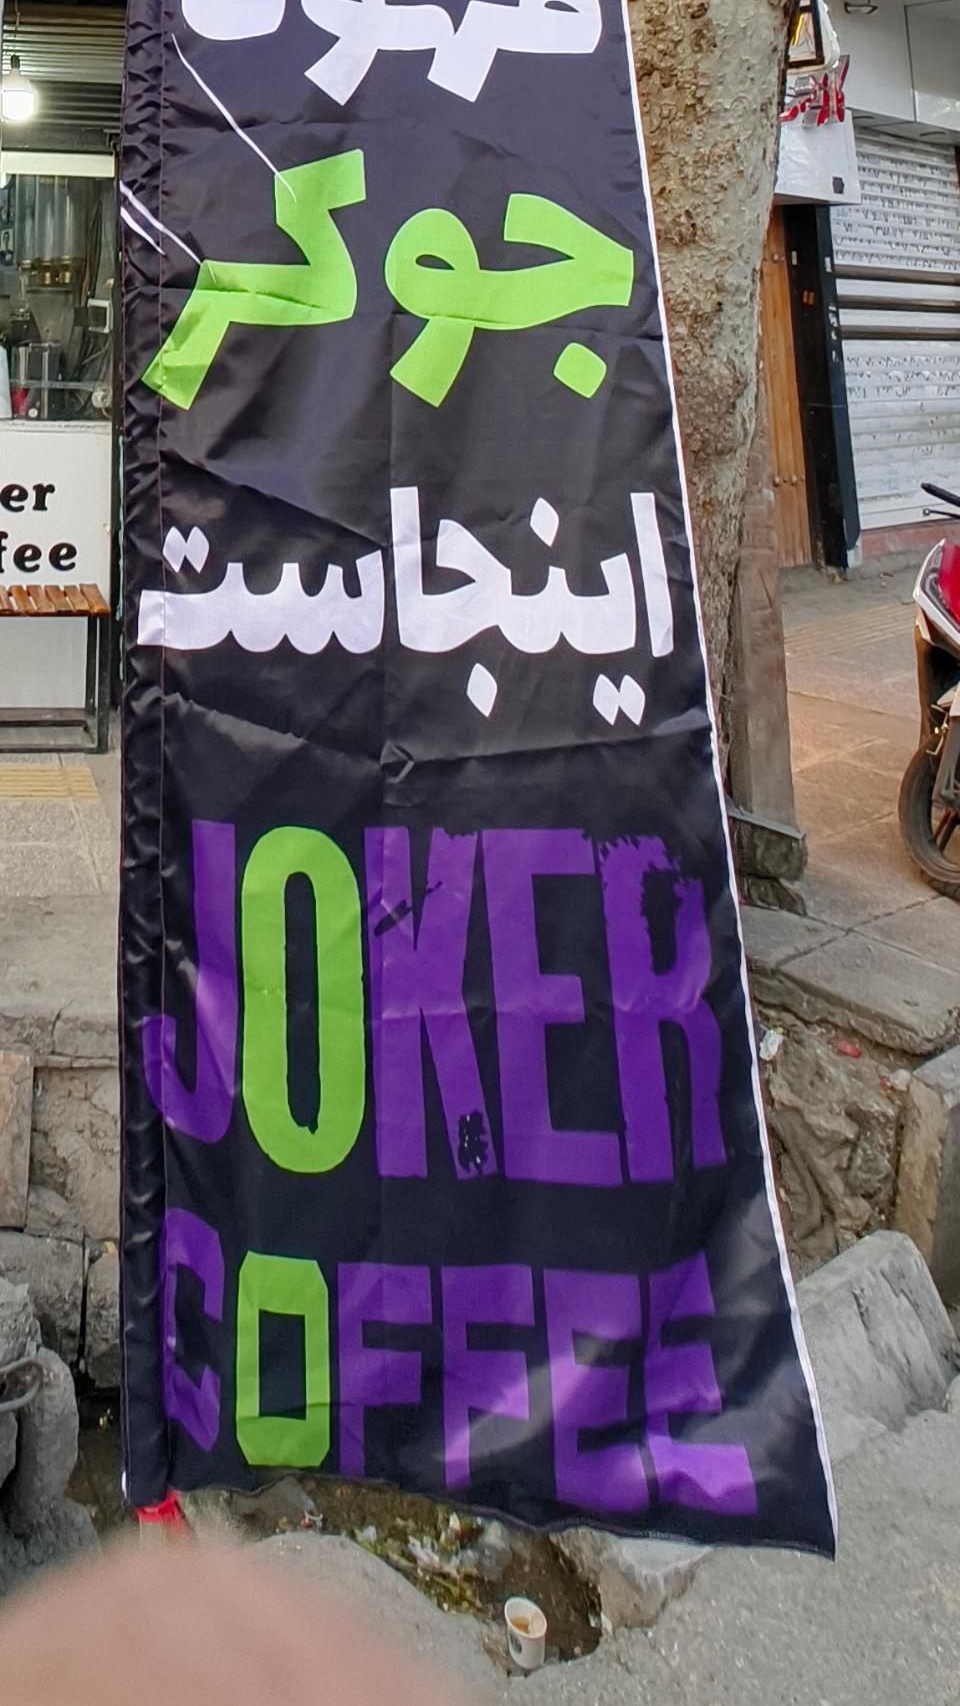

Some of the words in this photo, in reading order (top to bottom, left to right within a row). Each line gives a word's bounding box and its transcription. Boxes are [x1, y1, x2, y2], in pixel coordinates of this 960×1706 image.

[140, 147, 635, 411] جوکر
[136, 485, 676, 726] اینجاست
[142, 819, 728, 1187] JOKER
[160, 1205, 758, 1516] COFFEE
